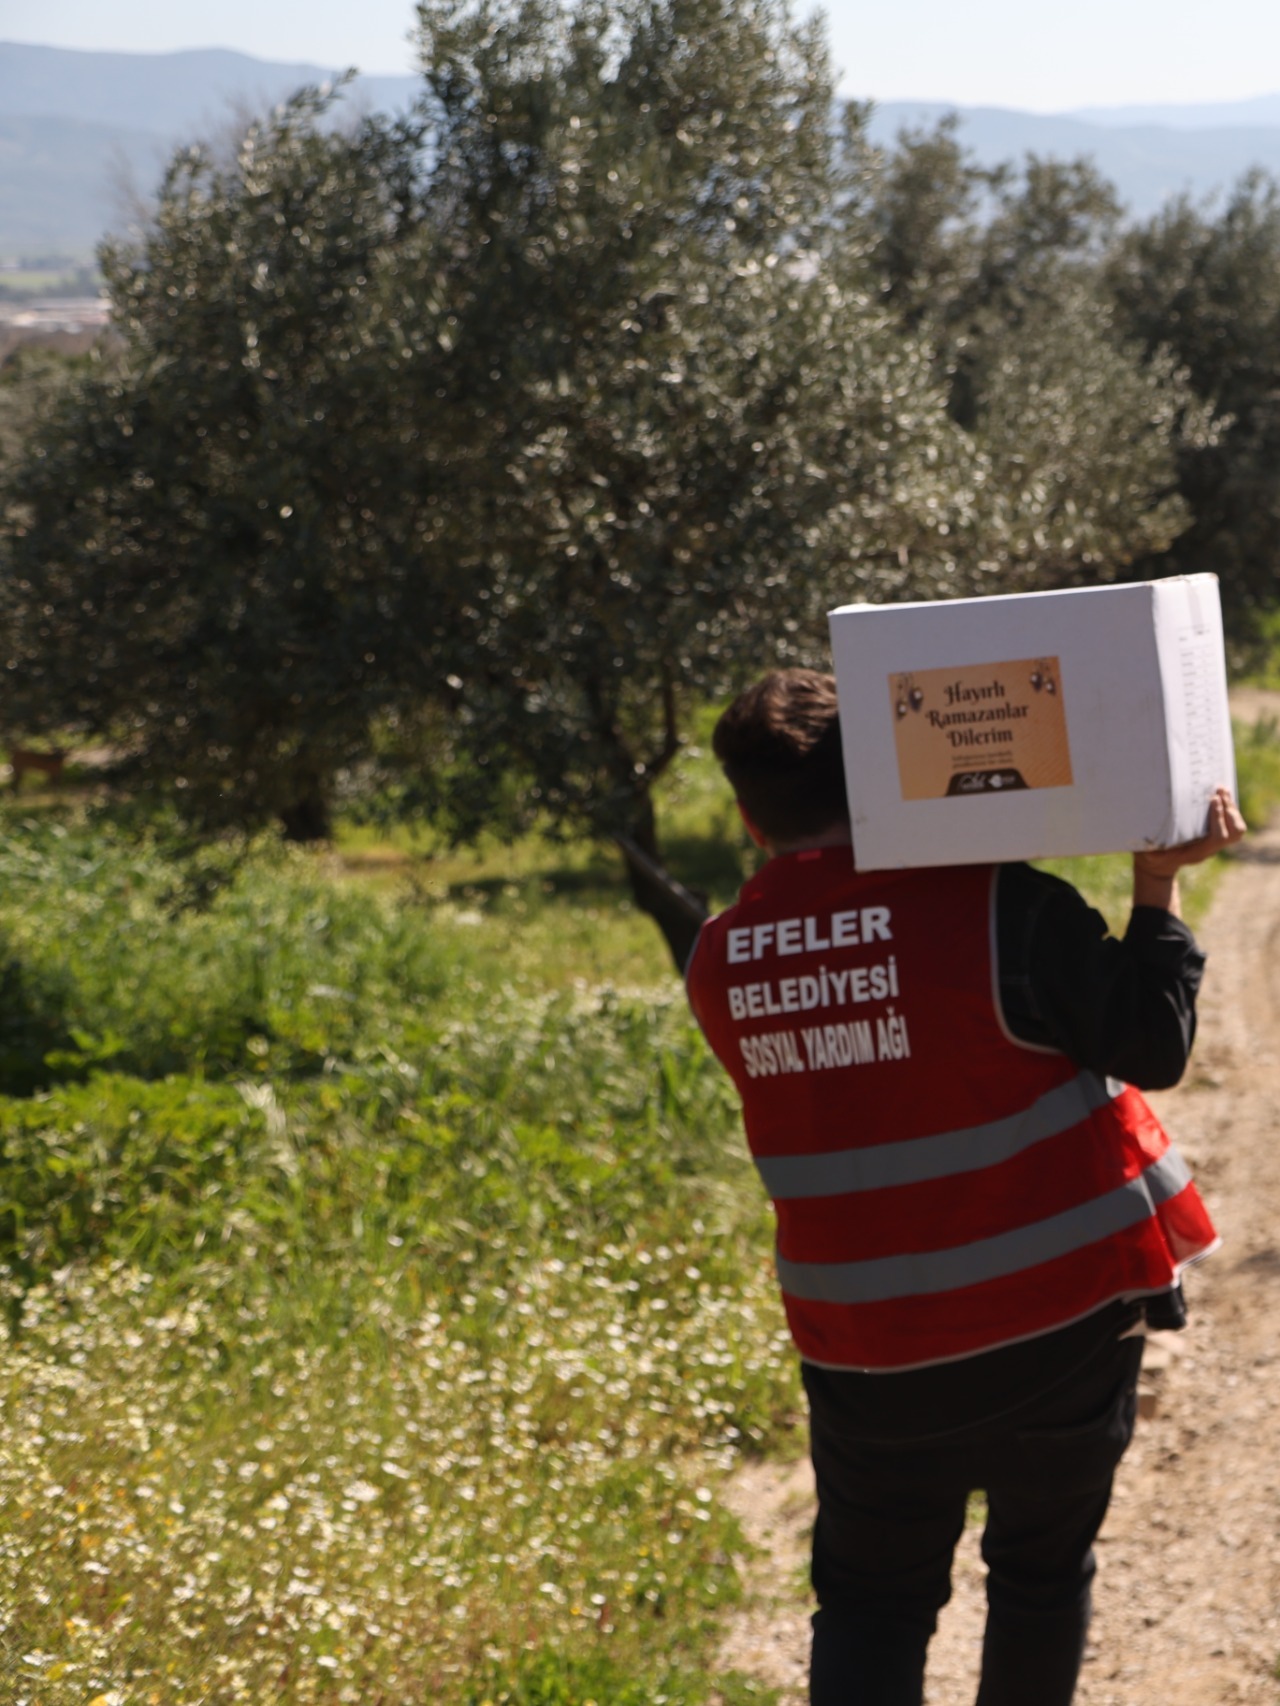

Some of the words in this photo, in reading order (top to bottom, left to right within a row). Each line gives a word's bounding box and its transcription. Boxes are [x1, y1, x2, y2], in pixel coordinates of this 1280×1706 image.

[925, 702, 1029, 730] Ramazanlar
[946, 728, 1013, 748] Dilerim
[727, 905, 893, 965] EFELER
[727, 955, 899, 1021] BELEDİYESİ
[739, 1030, 804, 1078] SOSYAL
[801, 1020, 875, 1071] YARDIM
[876, 1006, 911, 1062] AĞI
